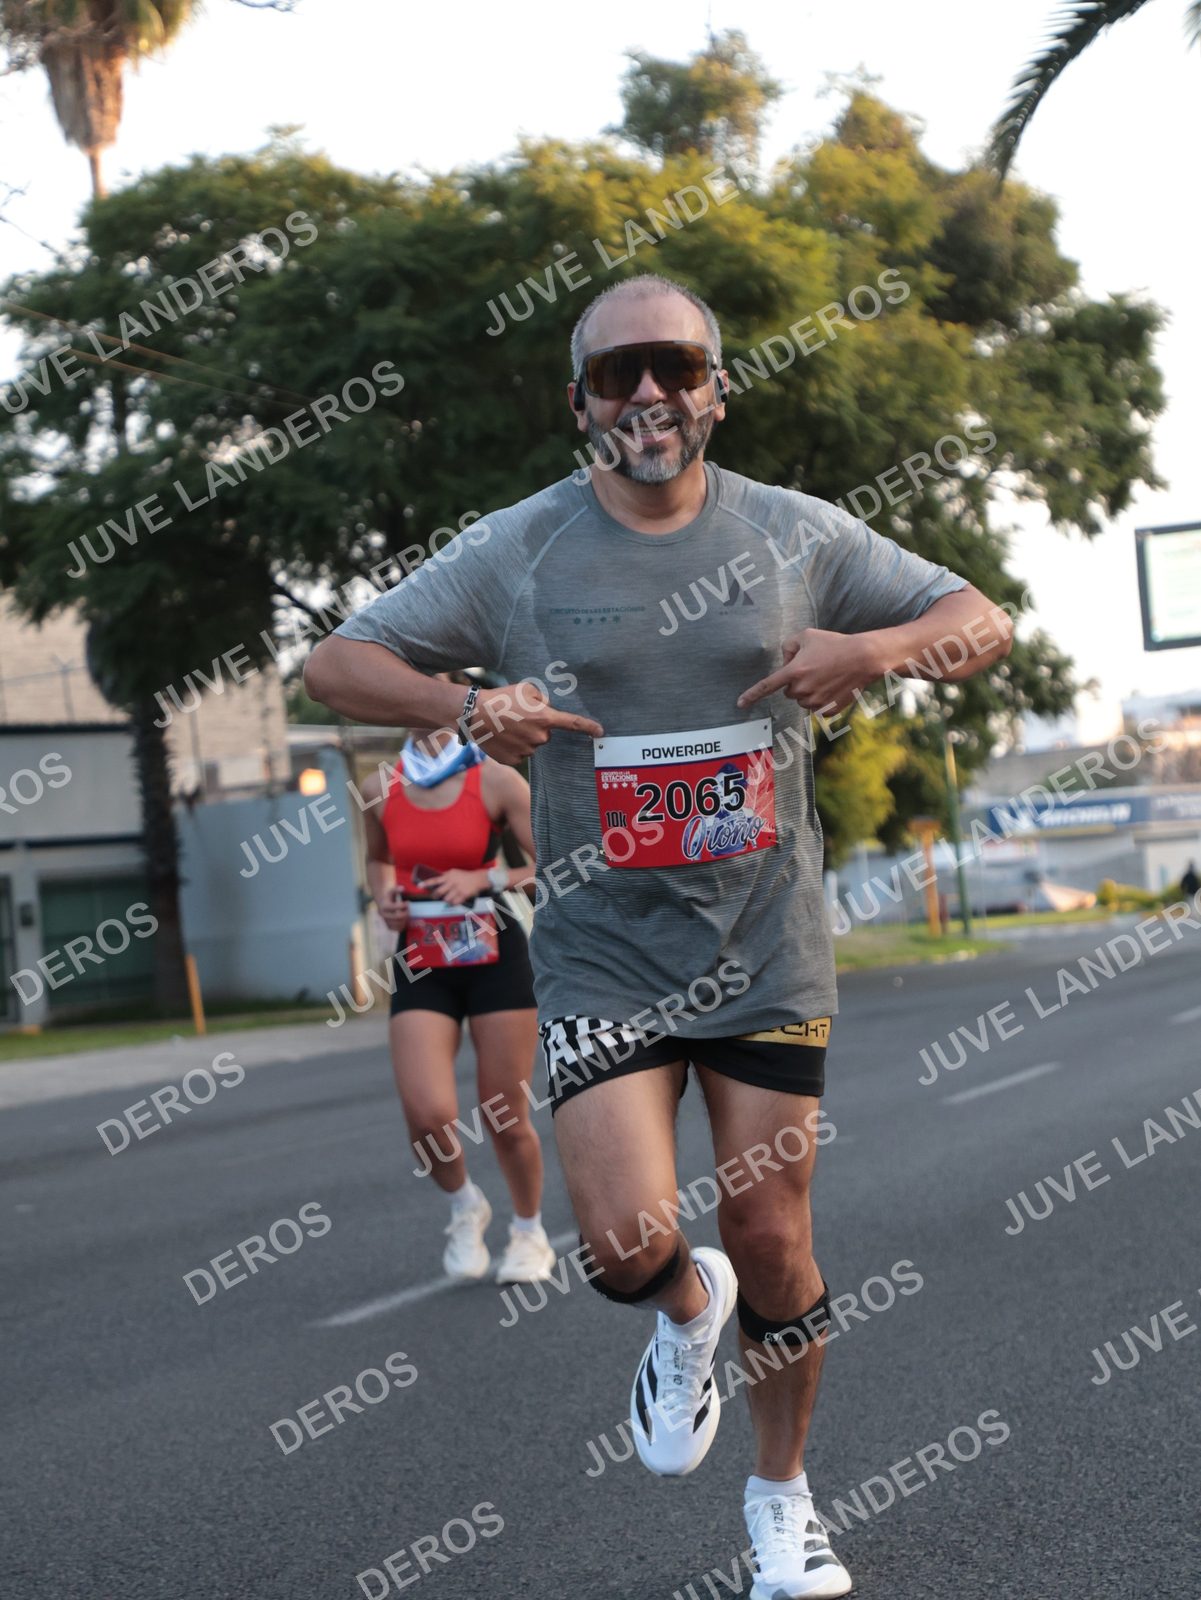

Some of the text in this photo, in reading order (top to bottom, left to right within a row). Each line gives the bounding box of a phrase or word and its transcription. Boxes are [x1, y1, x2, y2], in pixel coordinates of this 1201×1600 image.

[641, 740, 721, 760] POWERADE
[634, 771, 747, 824] 2065
[605, 811, 628, 828] 10k
